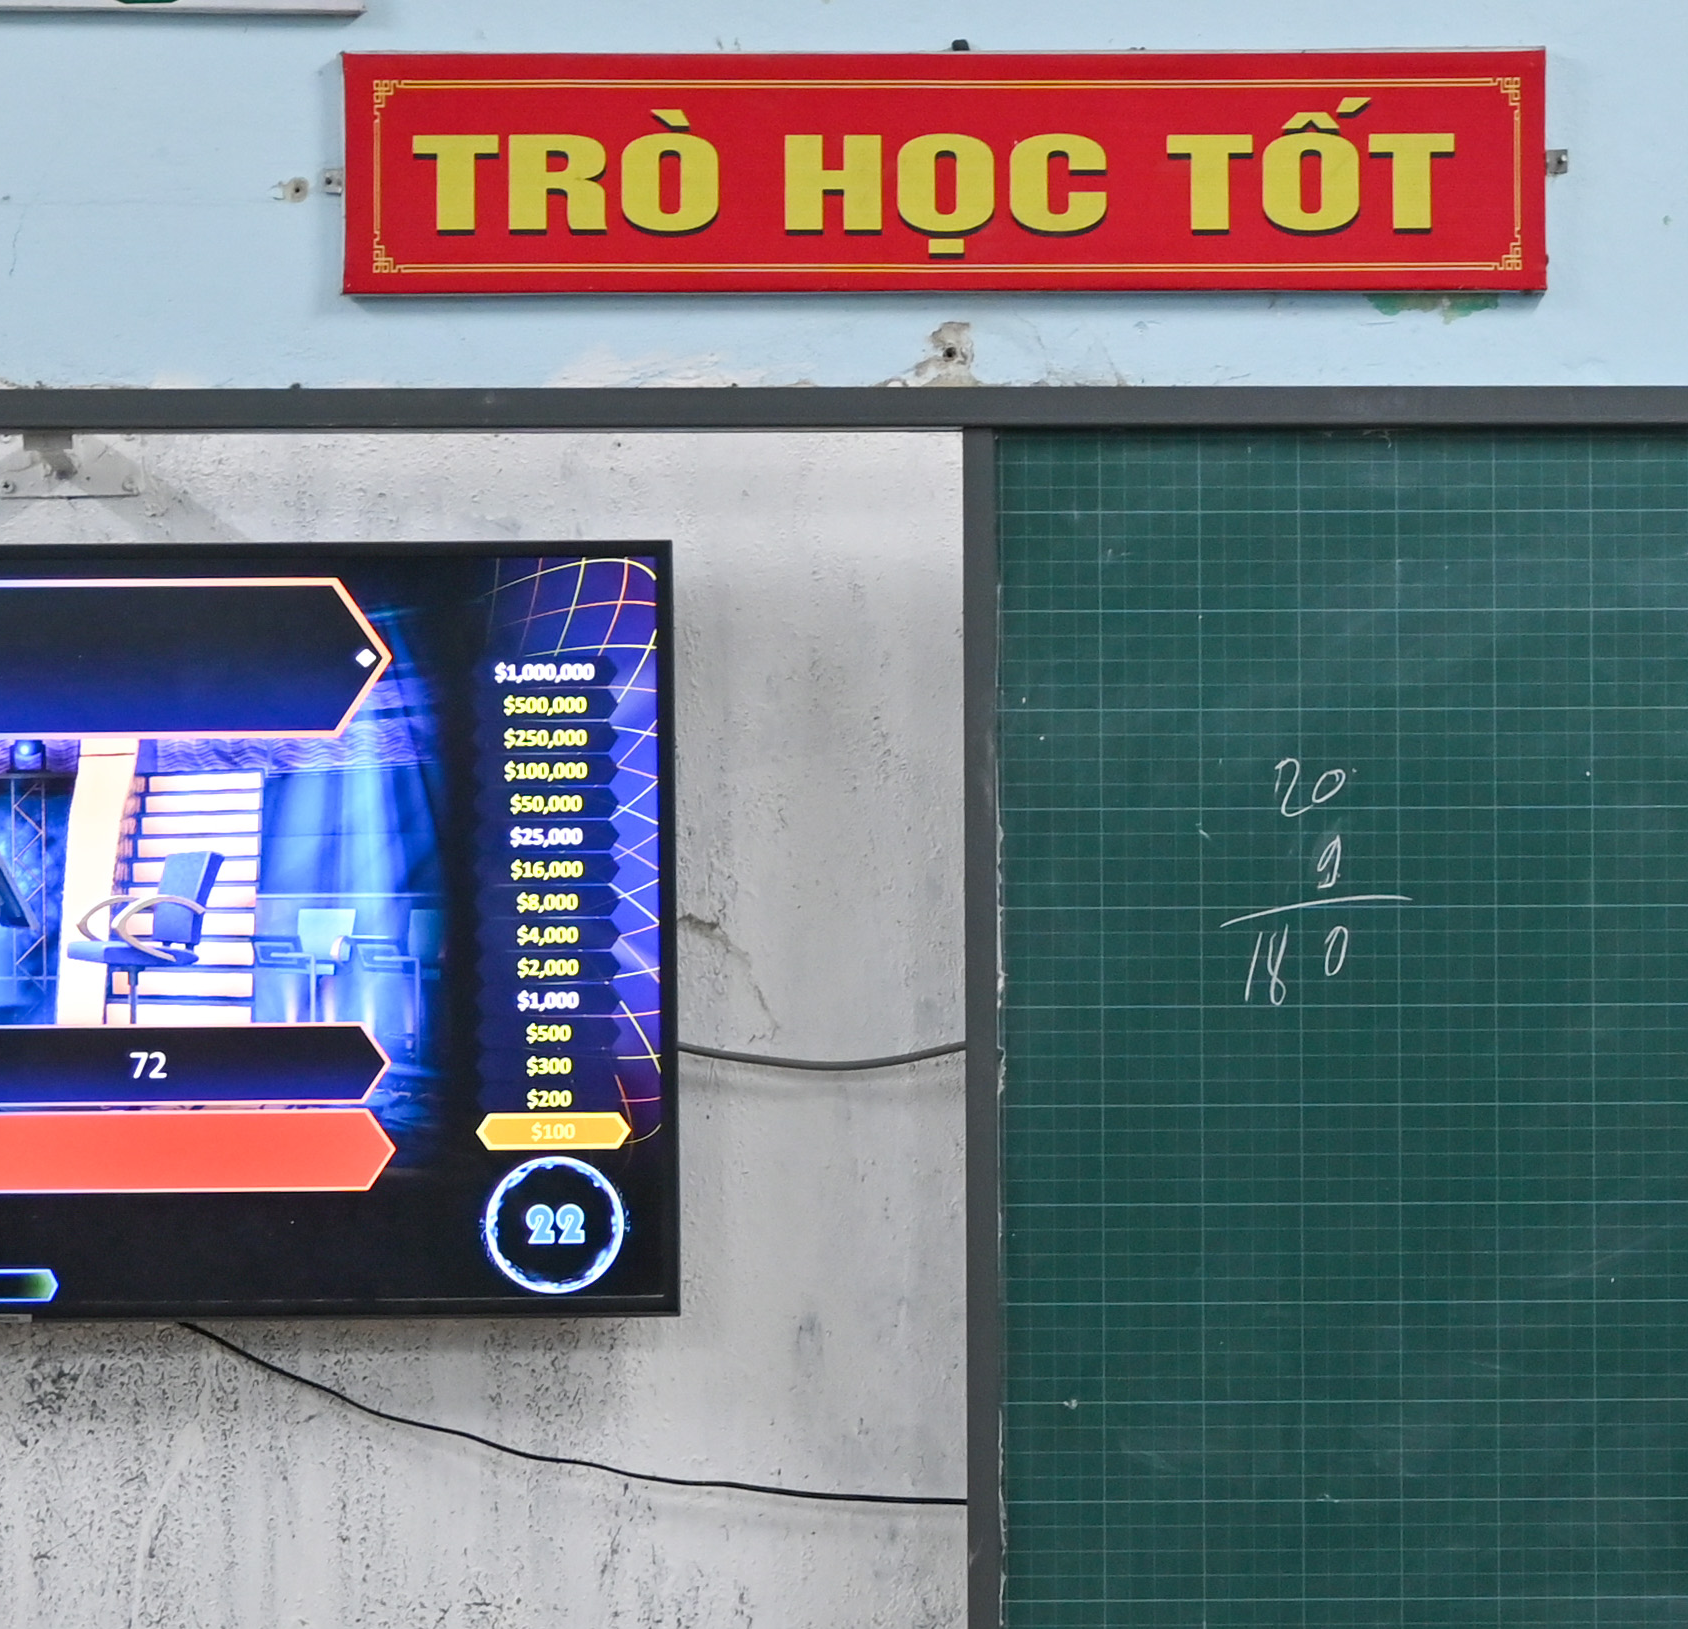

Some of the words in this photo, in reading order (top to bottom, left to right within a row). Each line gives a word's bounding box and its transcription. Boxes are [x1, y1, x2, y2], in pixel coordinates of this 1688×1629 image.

[413, 108, 720, 236] TRÒ
[783, 132, 1108, 256] HỌC
[1166, 97, 1456, 236] TỐT
[494, 662, 595, 684] $1,000,000
[503, 694, 588, 716] $500,000
[503, 727, 588, 749] $250,000
[504, 760, 588, 782] $100,000
[1274, 757, 1347, 818] 20
[510, 793, 583, 815] $50,000
[510, 826, 583, 848] $25,000
[510, 859, 584, 881] $16,000
[516, 891, 579, 914] $8,000
[516, 924, 579, 946] $4,000
[517, 957, 580, 979] $2,000
[517, 990, 580, 1012] $1,000
[526, 1022, 572, 1044] $500
[129, 1052, 167, 1079] 72
[526, 1055, 572, 1077] $300
[526, 1088, 573, 1110] $200
[531, 1122, 576, 1142] $100
[525, 1203, 585, 1245] 22
